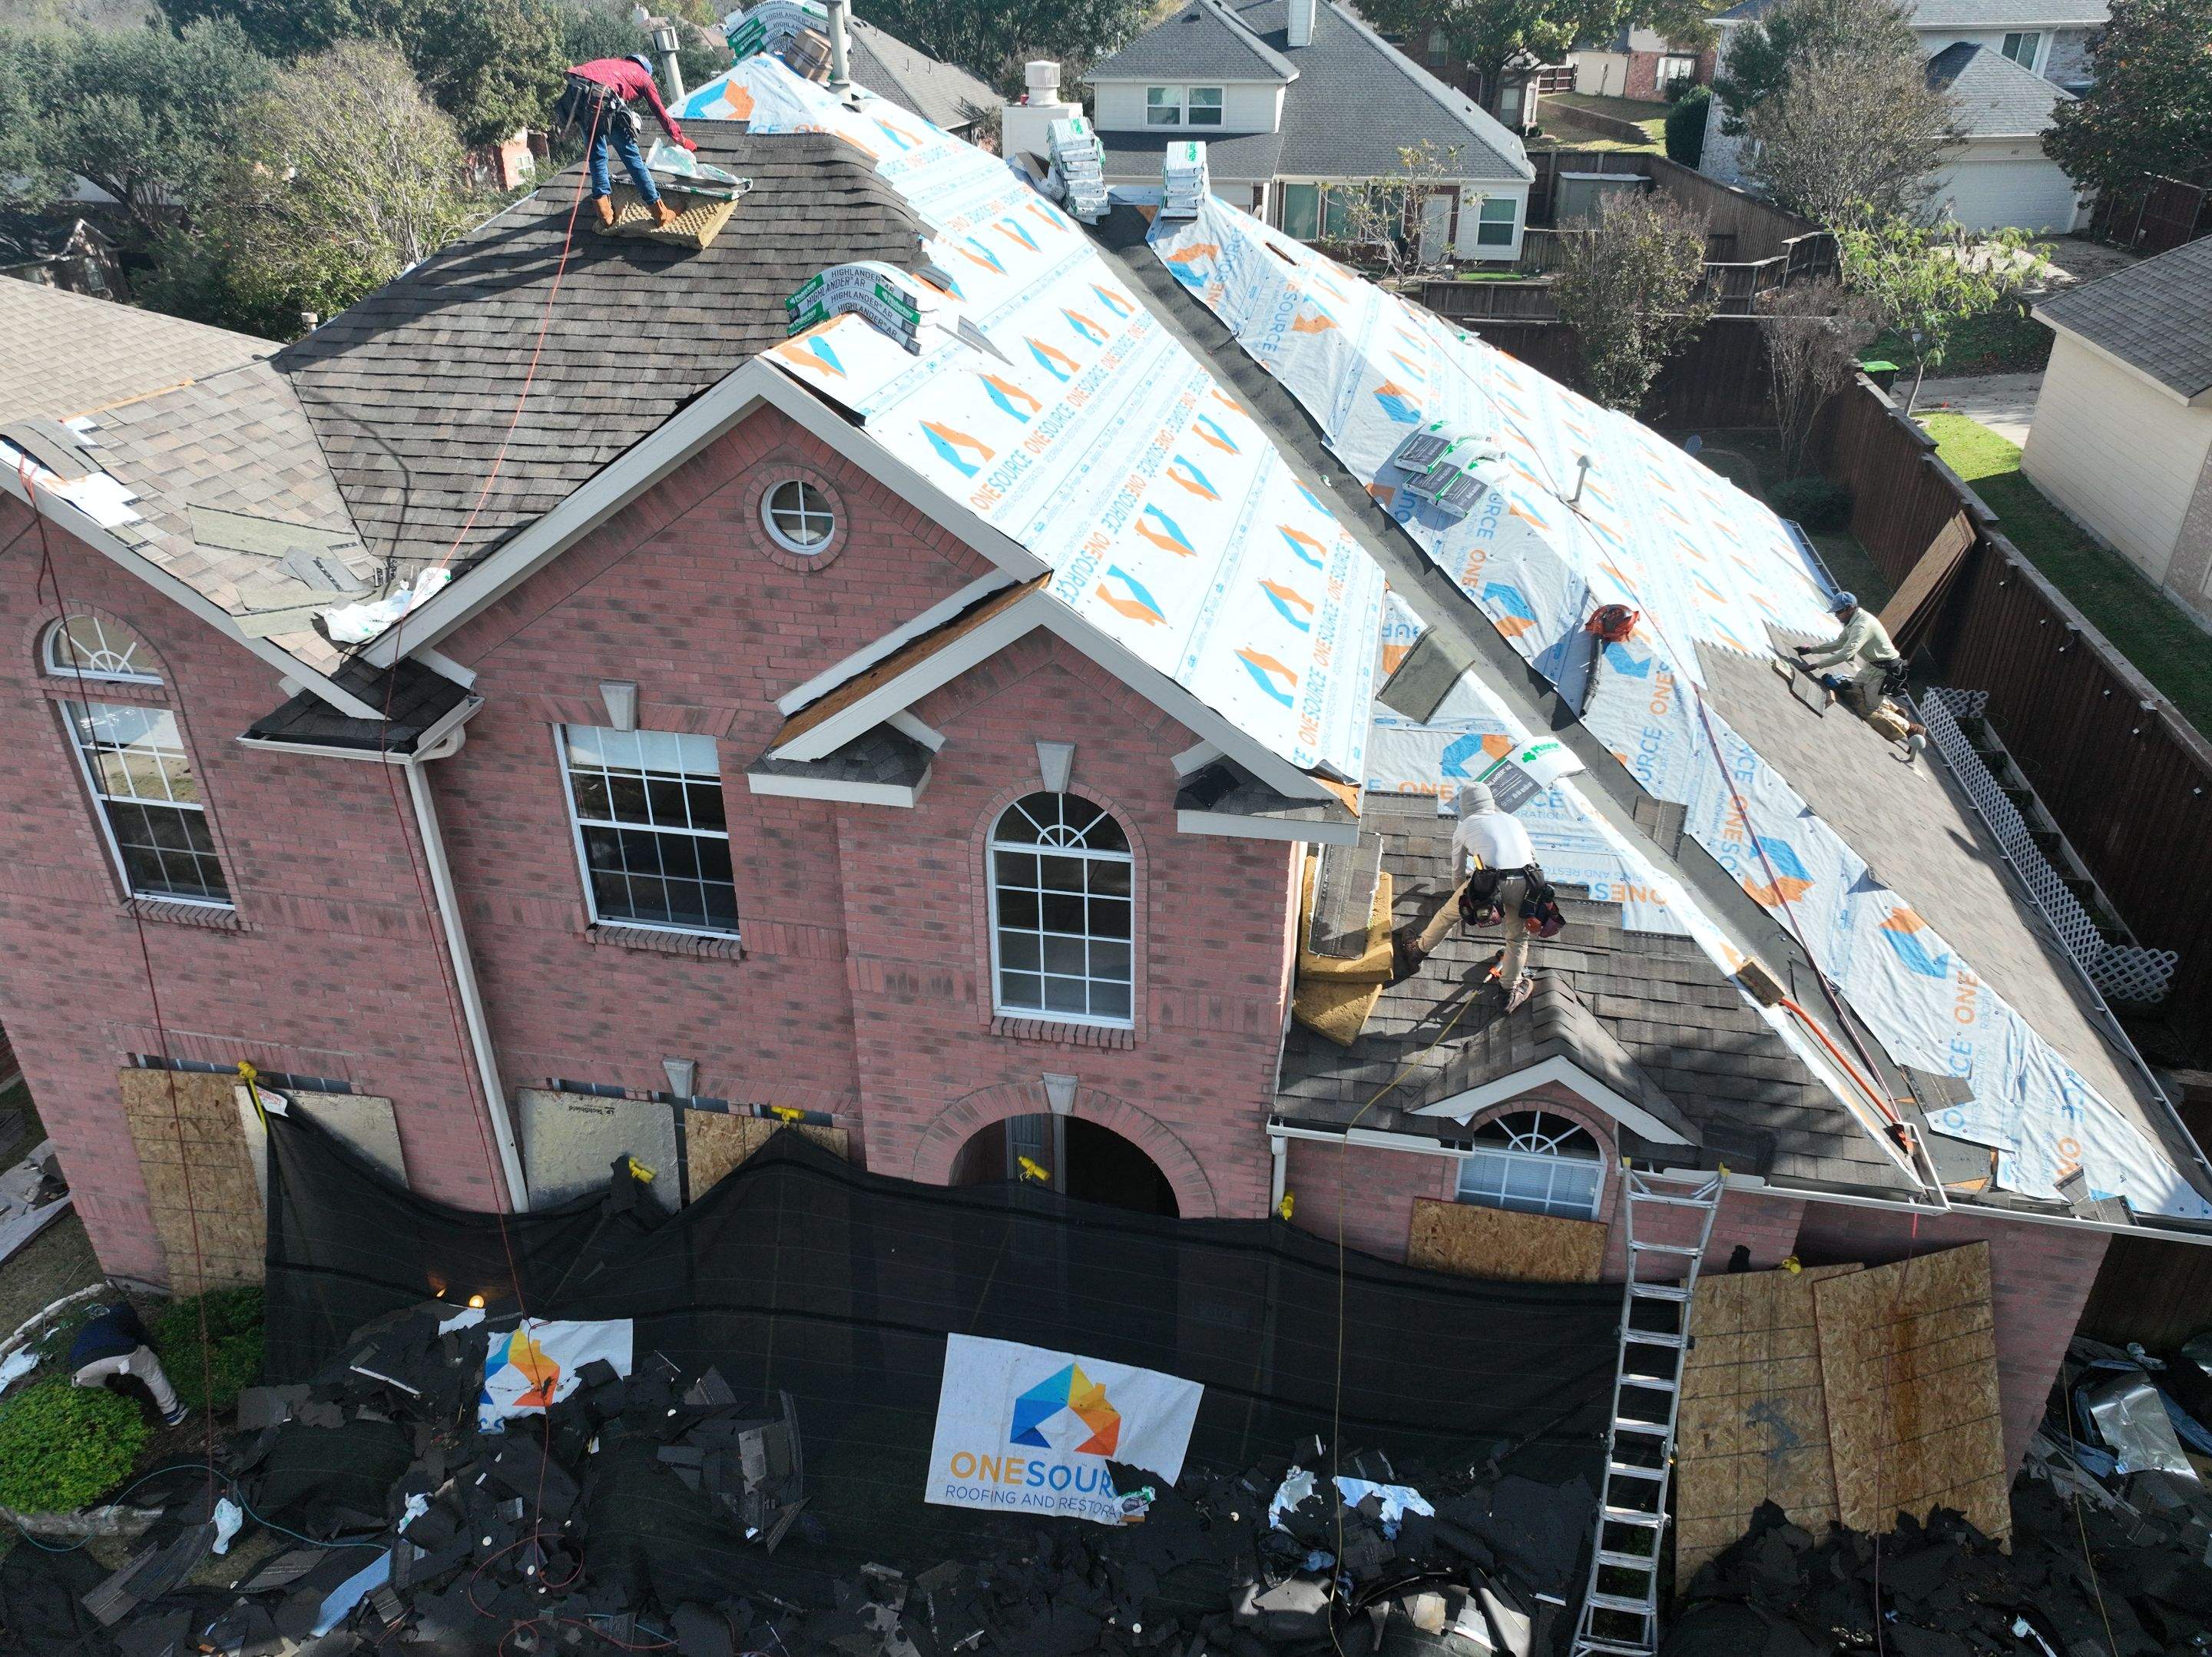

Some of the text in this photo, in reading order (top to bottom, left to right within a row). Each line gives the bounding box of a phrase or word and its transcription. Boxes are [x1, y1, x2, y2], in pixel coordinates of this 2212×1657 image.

[854, 277, 866, 287] AR
[885, 283, 895, 293] AR
[883, 307, 892, 320] AR
[886, 326, 897, 338] AR
[1023, 403, 1075, 454] ONESOURCE
[969, 449, 1033, 510] ONESOURCE
[1101, 473, 1147, 535] ONESOURCE
[1055, 530, 1111, 604] ONESOURCE
[1297, 665, 1328, 747] ONESOURCE
[950, 1451, 1121, 1499] ONESOUR
[945, 1484, 1124, 1519] ROOFING AND RESTORA
